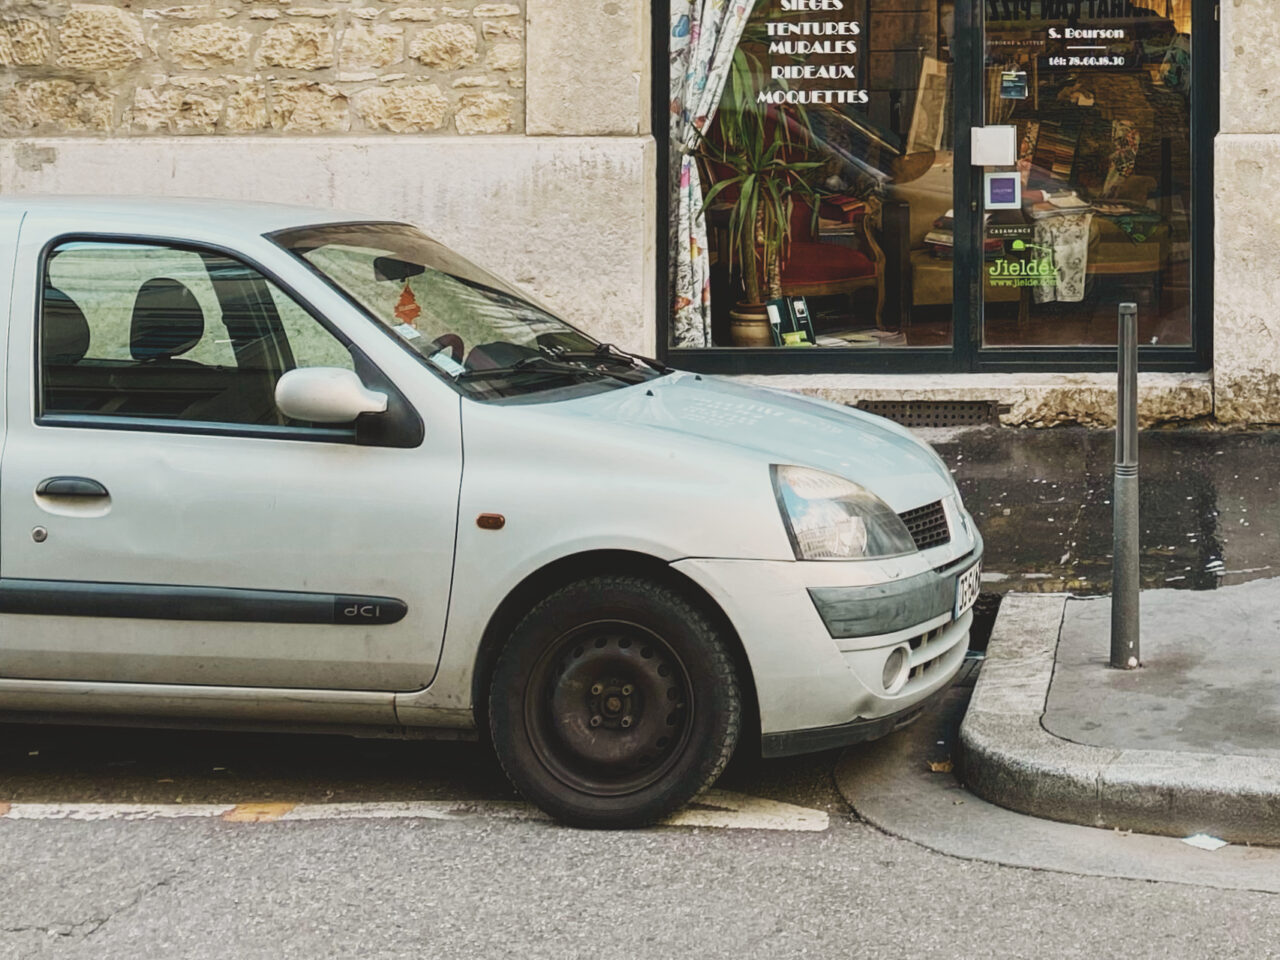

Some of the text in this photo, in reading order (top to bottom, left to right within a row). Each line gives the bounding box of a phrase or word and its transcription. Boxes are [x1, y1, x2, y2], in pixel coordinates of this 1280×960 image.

[765, 21, 861, 36] TENTURES
[1048, 28, 1125, 39] S. Bourson
[768, 40, 858, 55] MURALES
[771, 65, 856, 79] RIDEAUX
[756, 90, 869, 104] MOQUETTES
